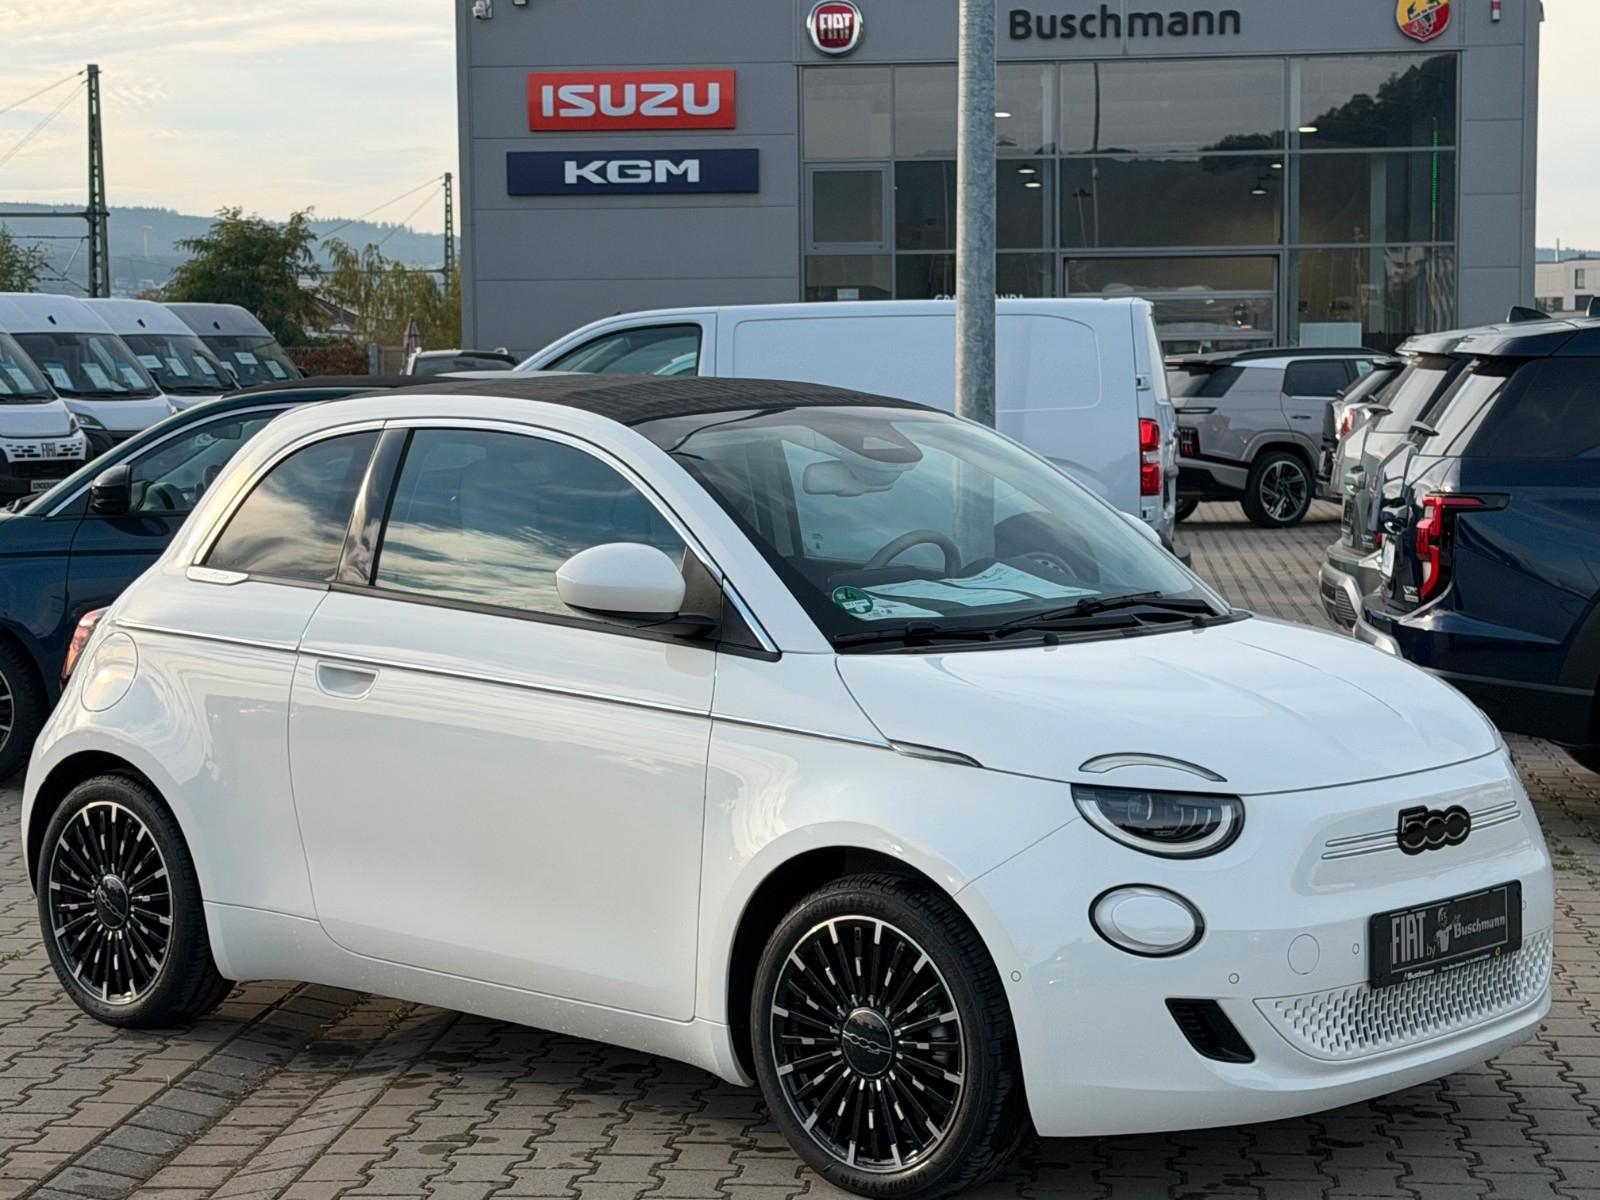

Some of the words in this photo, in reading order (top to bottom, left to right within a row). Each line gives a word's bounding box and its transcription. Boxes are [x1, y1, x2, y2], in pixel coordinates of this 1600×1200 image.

[819, 13, 852, 40] FIAT
[1009, 4, 1241, 40] Buschmann
[541, 82, 720, 118] ISUZU
[564, 159, 700, 184] KGM
[1397, 805, 1471, 856] 500
[1391, 911, 1426, 965] FIAT
[1426, 943, 1436, 958] by
[1453, 915, 1505, 939] Buschmann
